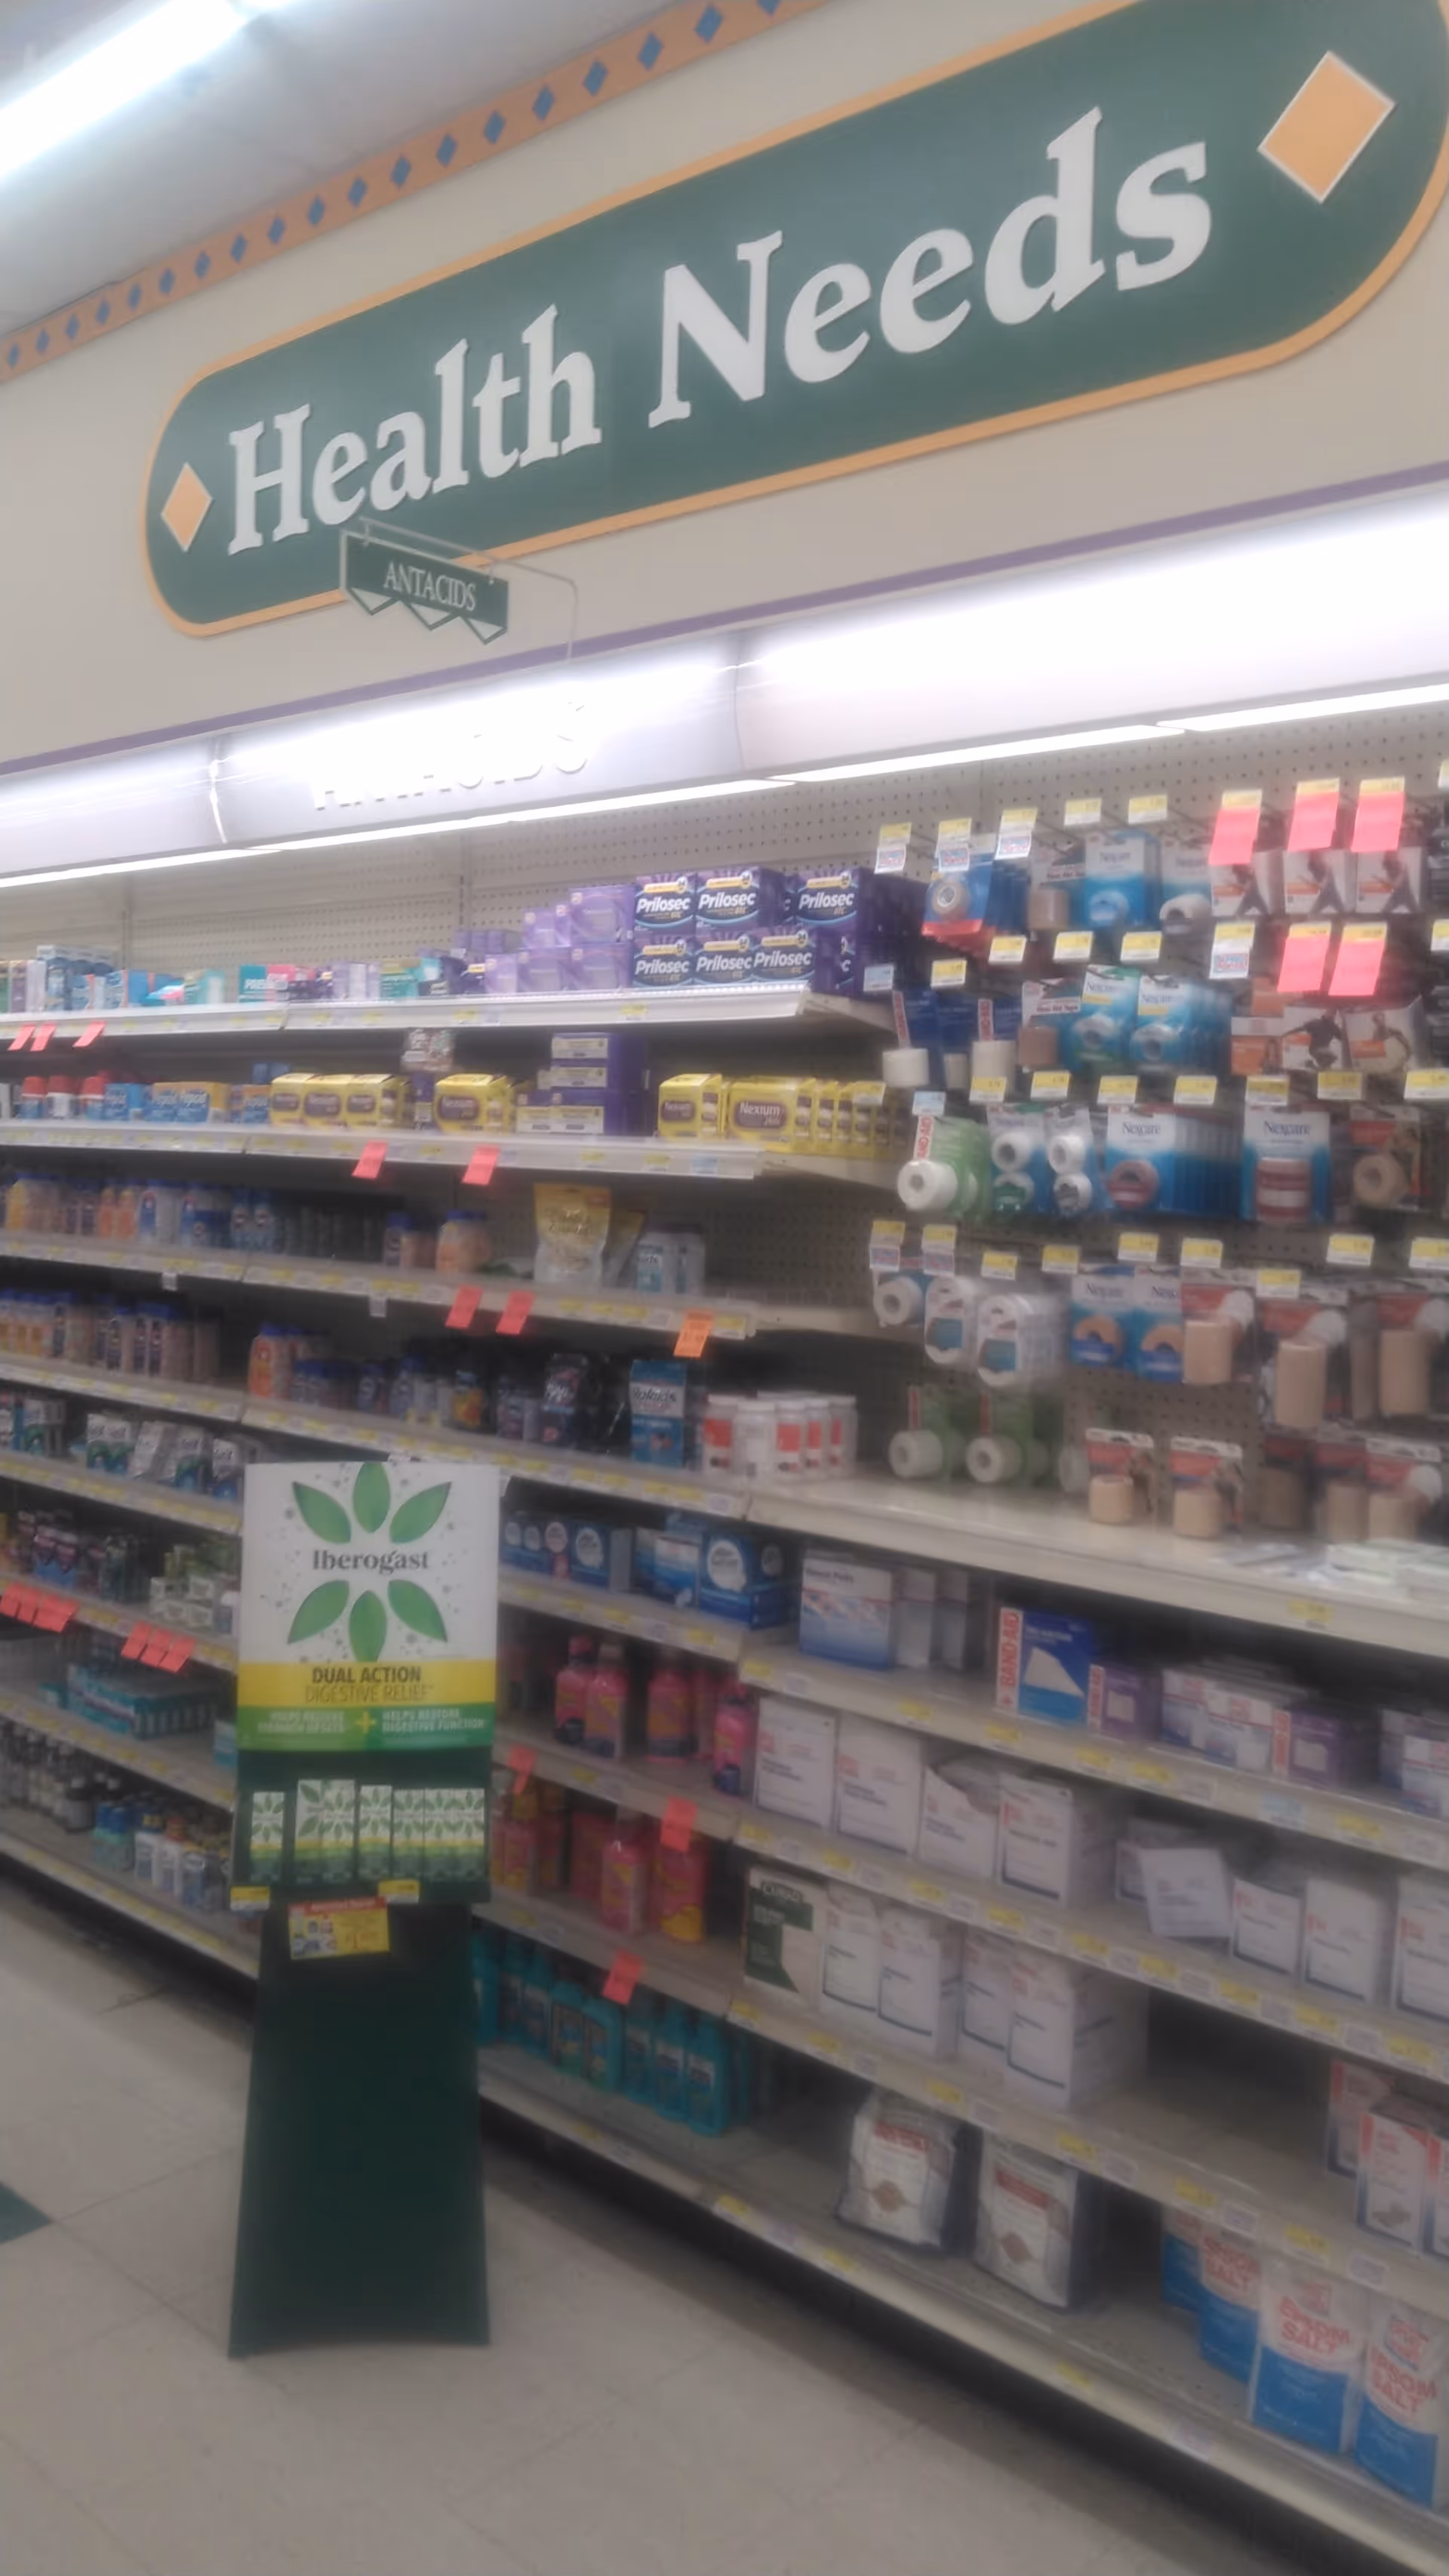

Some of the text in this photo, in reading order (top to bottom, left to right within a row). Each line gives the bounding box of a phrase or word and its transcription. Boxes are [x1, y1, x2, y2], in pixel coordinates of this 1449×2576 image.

[226, 105, 1213, 556] Health Needs
[383, 560, 477, 611] ANTACIDS
[637, 897, 691, 913] Prilosec
[698, 892, 756, 909] Prilosec
[798, 892, 854, 909] Prilosec
[635, 959, 689, 975] Prilosec
[697, 955, 752, 972] Prilosec
[754, 950, 811, 967] Prilosec
[740, 1101, 780, 1116] Nexium
[1122, 1122, 1161, 1136] Nexcare
[1264, 1121, 1312, 1137] Nexcare
[312, 1549, 429, 1574] Iberogast
[1001, 1612, 1020, 1687] BAND-AID
[312, 1666, 423, 1684] DUAL ACTION
[305, 1685, 378, 1703] DIGESTIVE
[1282, 2323, 1337, 2355] SALT
